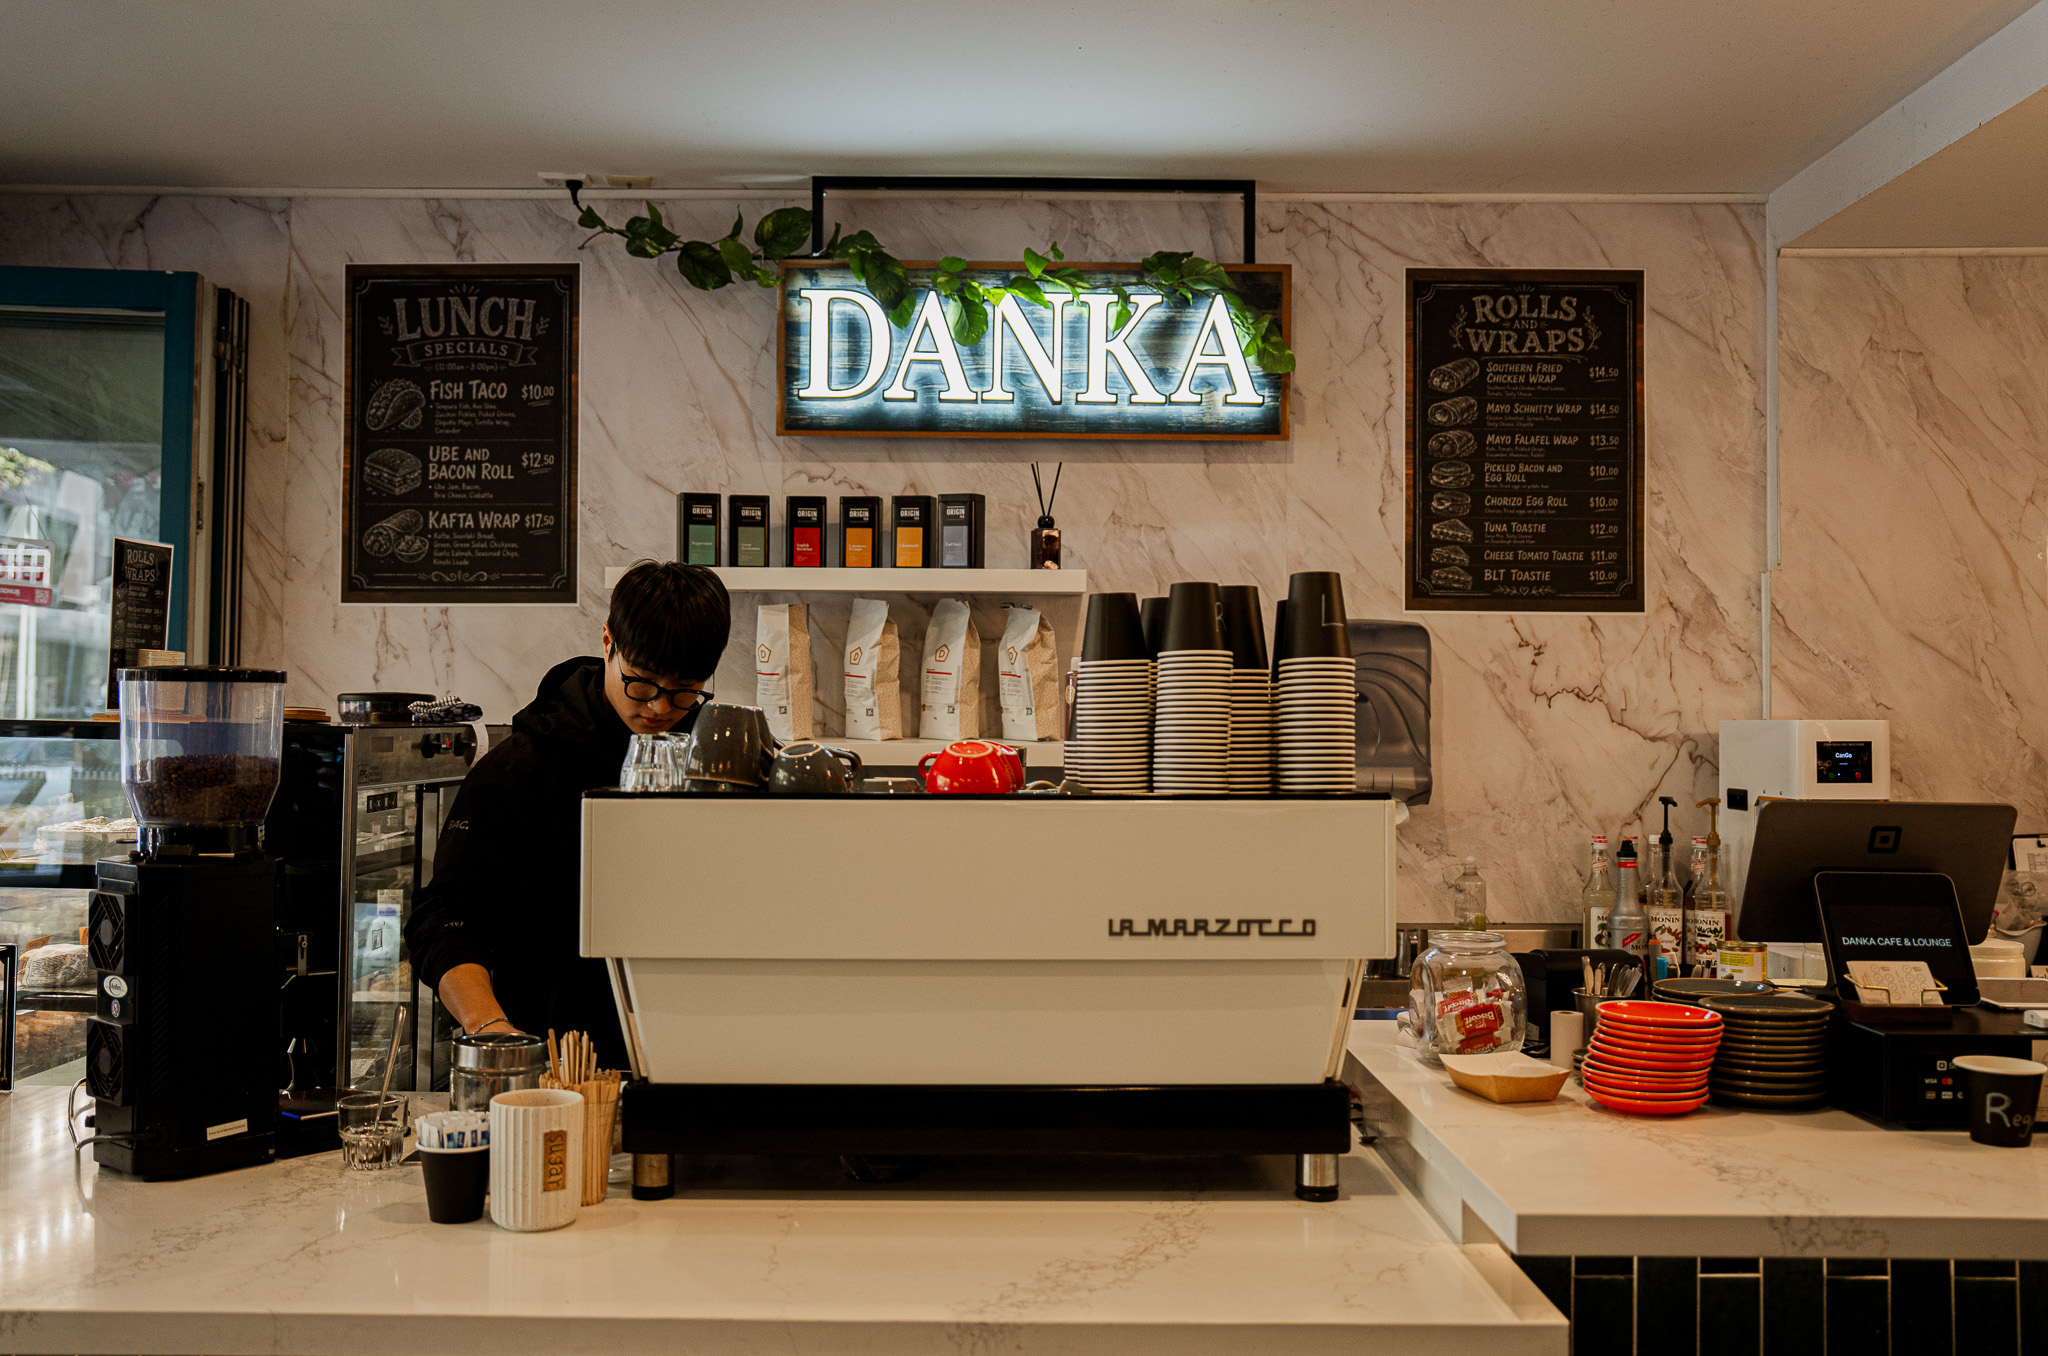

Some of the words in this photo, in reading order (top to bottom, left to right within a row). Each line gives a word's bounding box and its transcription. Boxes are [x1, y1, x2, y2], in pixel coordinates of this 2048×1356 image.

[1472, 294, 1577, 324] ROLLS
[393, 296, 537, 341] LUNCH
[1512, 320, 1538, 329] AND
[798, 288, 1264, 405] DANKA
[1465, 327, 1585, 354] WRAPS
[424, 341, 509, 357] SPECIALS
[1486, 362, 1532, 373] SOUTHERN
[1536, 362, 1563, 373] FRIED
[1486, 373, 1524, 384] CHICKEN
[1529, 374, 1556, 384] WRAP
[1589, 367, 1619, 378] $14.50
[430, 380, 463, 400] FISH
[468, 380, 508, 400] TACO
[522, 384, 554, 400] $10.00
[1486, 402, 1510, 413] MAYO
[1514, 403, 1553, 414] SCHNITTY
[1556, 403, 1582, 414] WRAP
[1590, 403, 1619, 415] $14.50
[1486, 434, 1511, 445] MAYO
[1515, 434, 1550, 445] FALAFEL
[1553, 435, 1578, 445] WRAP
[1590, 435, 1619, 446] $13.50
[429, 446, 460, 461] UBE
[464, 448, 490, 461] AND
[522, 452, 554, 468] $12.50
[428, 464, 476, 480] BACON
[482, 464, 514, 480] ROLL
[1484, 462, 1516, 472] PICKLED
[1518, 463, 1544, 472] BACON
[1589, 466, 1618, 477] $10.00
[1485, 472, 1502, 482] EGG
[1506, 473, 1526, 482] ROLL
[1485, 495, 1522, 506] CHORIZO
[1526, 496, 1544, 506] EGG
[1547, 496, 1568, 506] ROLL
[1589, 498, 1618, 508] $10.00
[428, 510, 474, 528] KAFTA
[478, 511, 520, 528] WRAP
[524, 514, 554, 528] $17.50
[1484, 522, 1507, 532] TUNA
[1511, 522, 1546, 533] TOASTIE
[1589, 524, 1618, 535] $12.00
[126, 549, 155, 565] ROLLS
[1484, 550, 1514, 560] CHEESE
[1516, 550, 1549, 560] TOMATO
[1552, 550, 1584, 561] TOASTIE
[1591, 550, 1618, 561] $11.00
[125, 566, 155, 582] WRAPS
[1484, 569, 1506, 581] BLT
[1510, 569, 1551, 581] TOASTIE
[1590, 570, 1618, 581] $10.00
[1109, 919, 1133, 936] LA
[1148, 919, 1316, 936] MARZOCCO
[1842, 936, 1876, 945] DANKA
[1877, 937, 1902, 946] CAFE
[1904, 938, 1911, 946] &
[1912, 938, 1952, 947] LOUNGE
[1464, 1012, 1495, 1025] Biscoff
[548, 1134, 563, 1186] sugar
